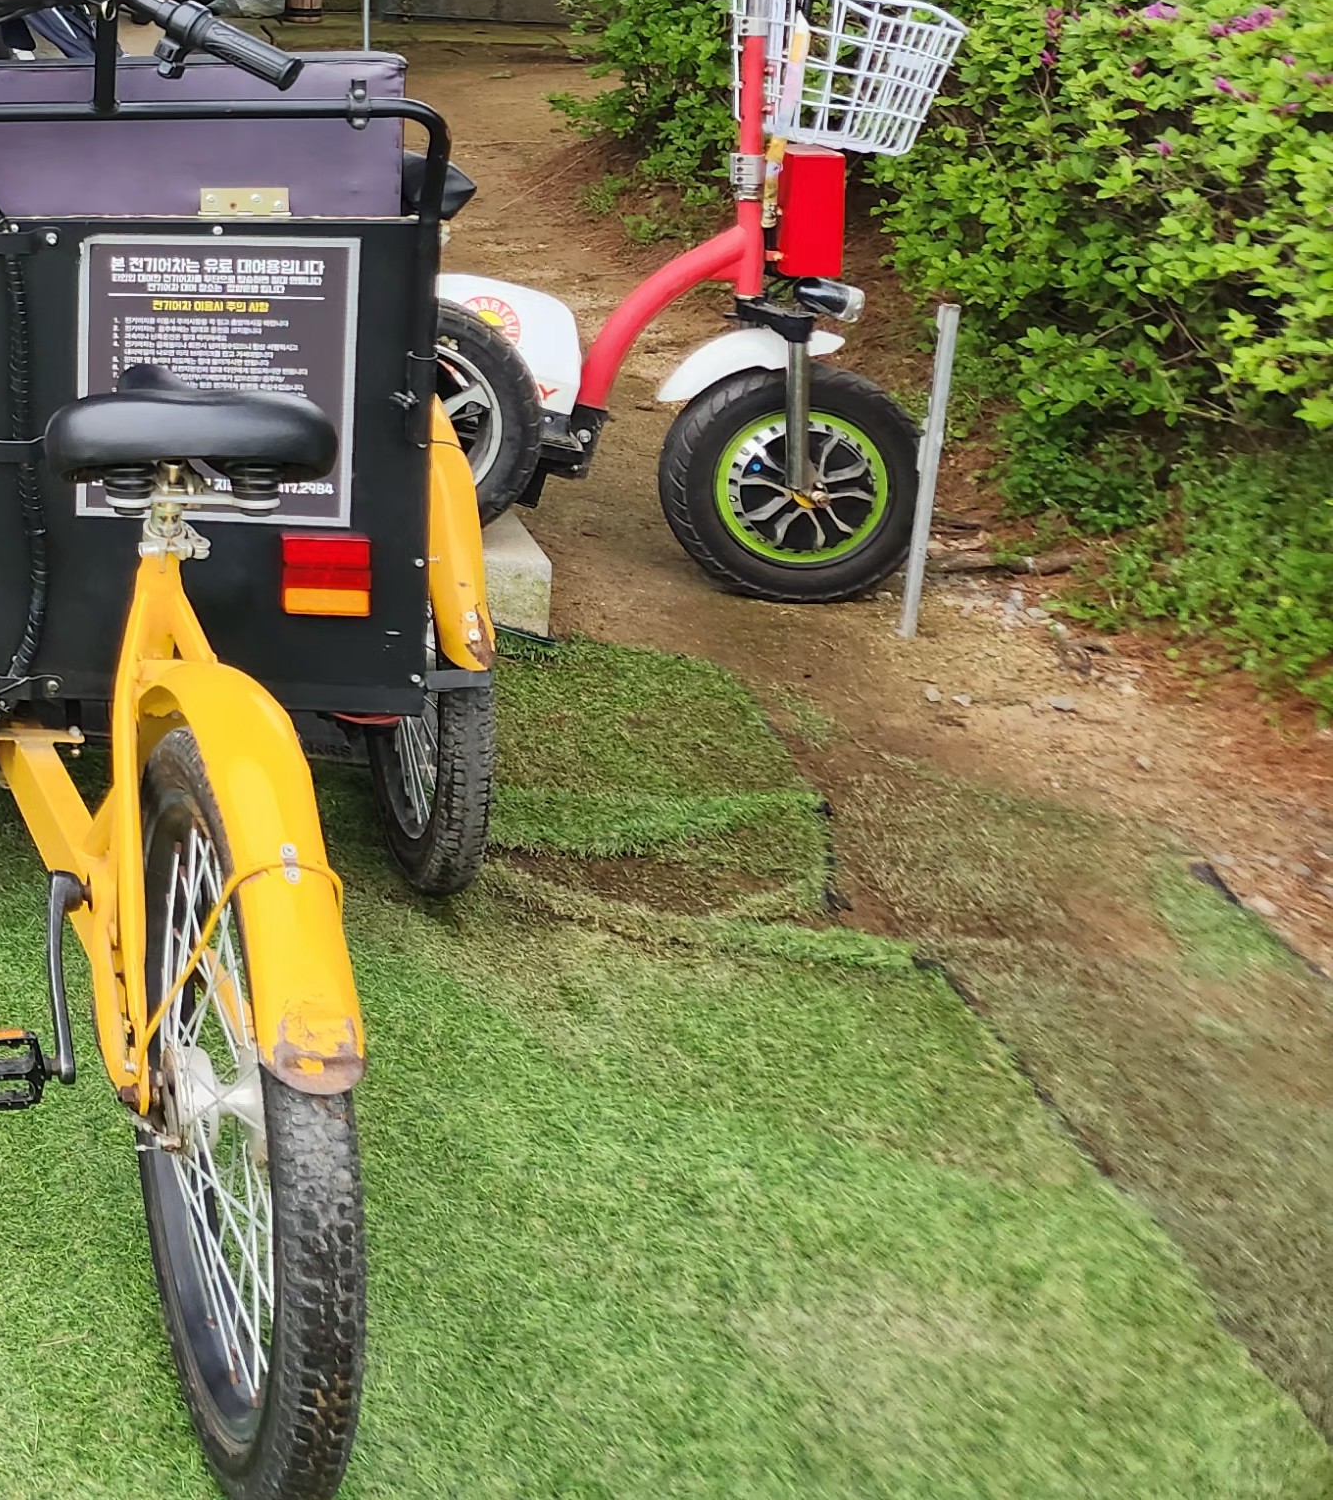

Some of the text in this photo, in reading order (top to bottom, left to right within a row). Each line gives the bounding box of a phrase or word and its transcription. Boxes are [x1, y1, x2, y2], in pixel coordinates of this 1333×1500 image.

[110, 256, 324, 275] 본 전기어차는 유료 대여용입니다
